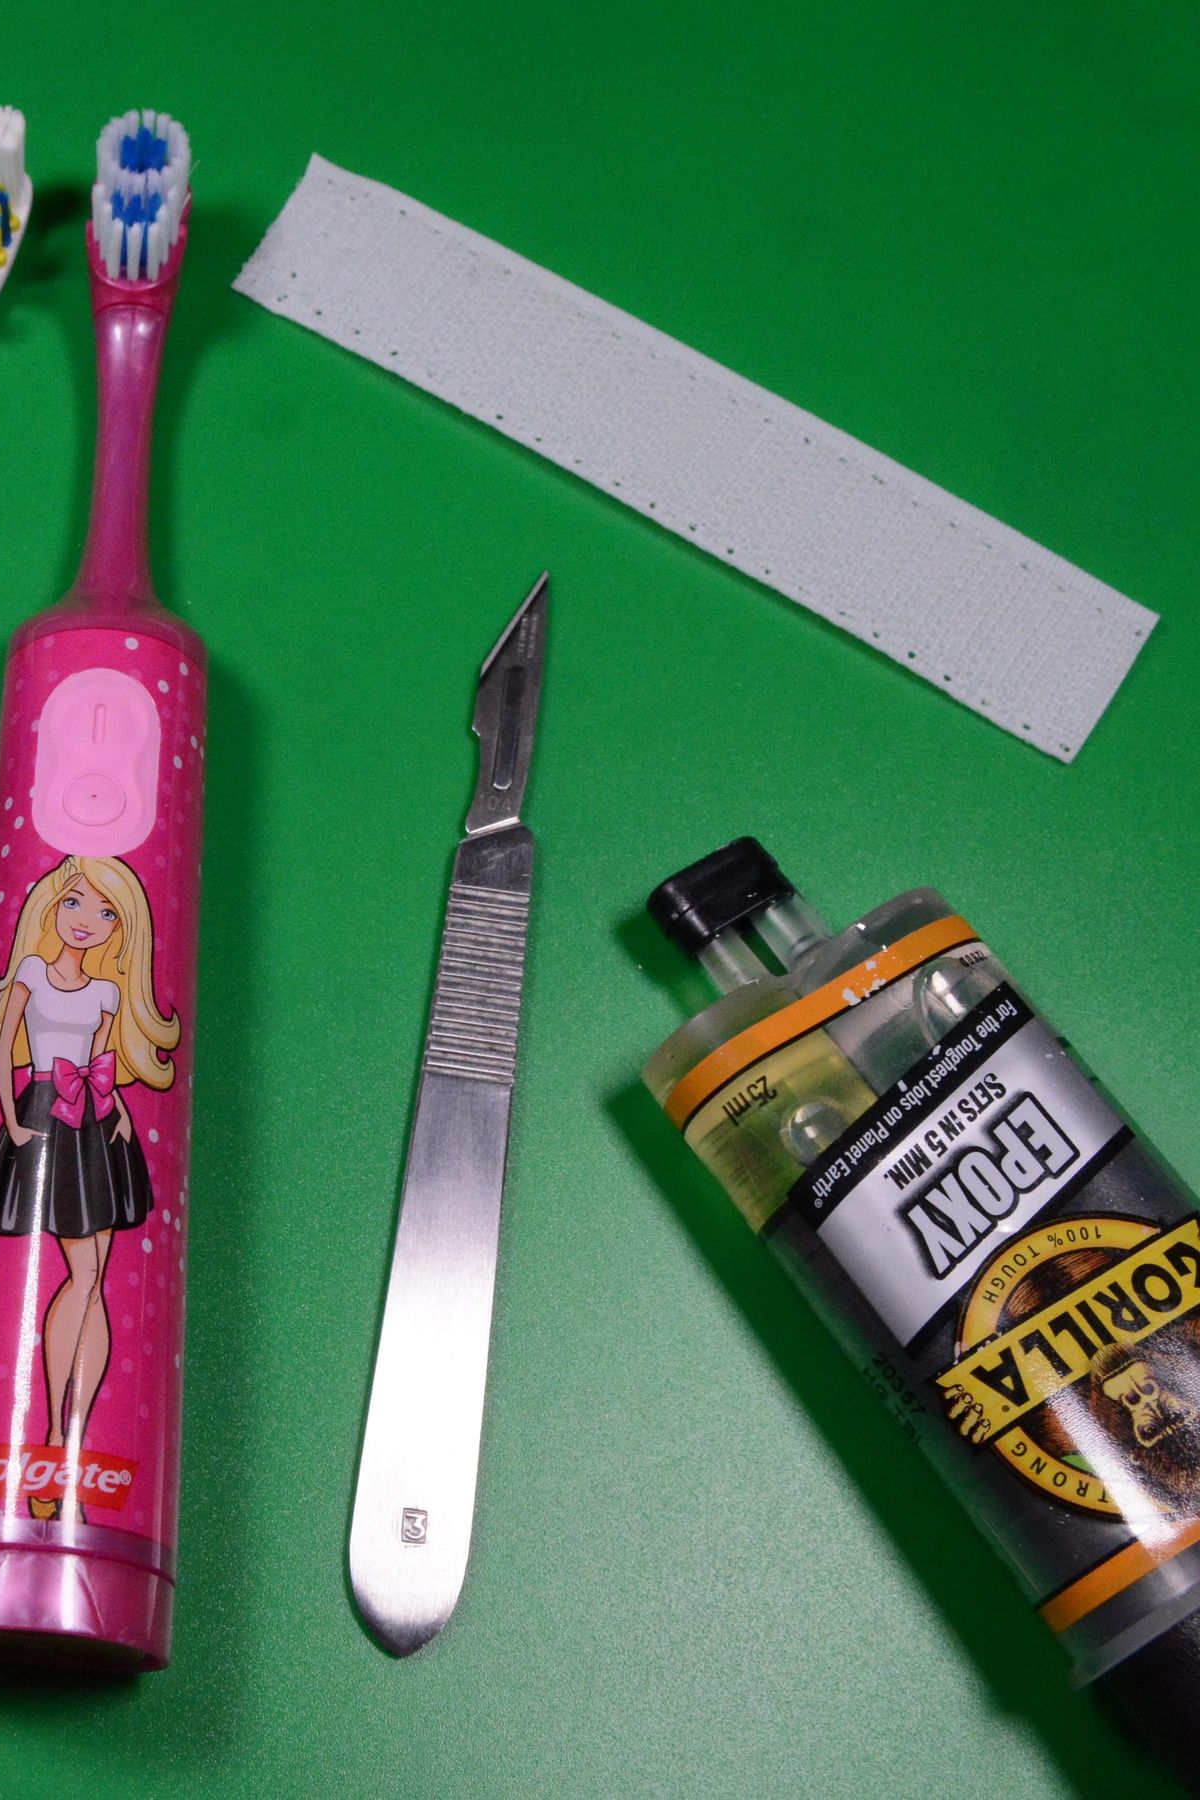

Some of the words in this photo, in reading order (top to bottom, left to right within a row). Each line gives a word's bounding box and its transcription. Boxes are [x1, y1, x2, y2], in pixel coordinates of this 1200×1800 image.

[976, 1014, 1000, 1038] the
[996, 1000, 1018, 1022] For
[926, 1034, 983, 1089] Toughest
[900, 1080, 931, 1110] Jobs
[958, 1072, 1007, 1123] SETS
[883, 1107, 902, 1126] on
[938, 1110, 966, 1142] IN
[844, 1120, 890, 1165] Planet
[924, 1129, 948, 1158] 5
[883, 1143, 933, 1191] MIN.
[905, 1095, 1078, 1277] EPOXY
[1047, 1226, 1102, 1248] 100%
[983, 1244, 1040, 1304] TOUGH
[969, 1241, 1200, 1407] GORILLA
[1011, 1441, 1110, 1504] TRONG
[404, 1511, 427, 1540] 3
